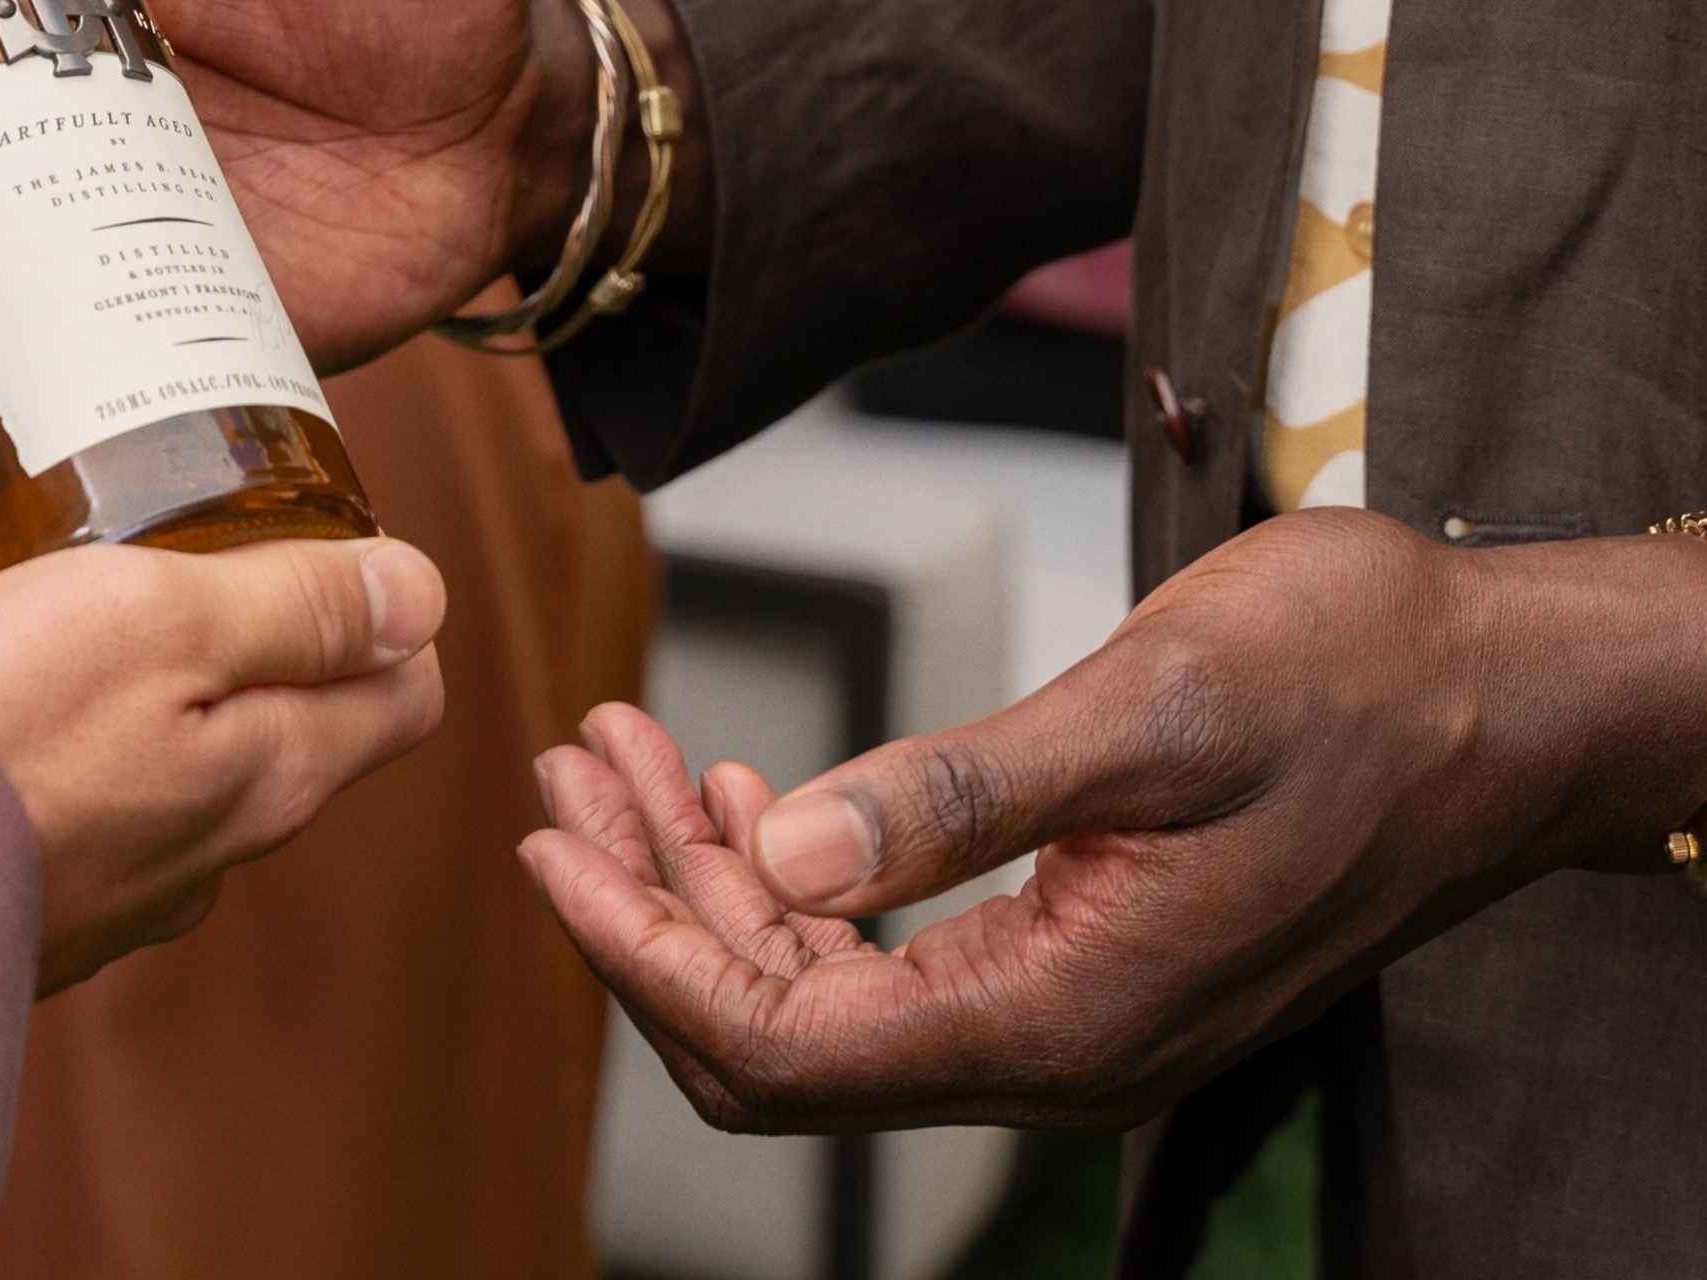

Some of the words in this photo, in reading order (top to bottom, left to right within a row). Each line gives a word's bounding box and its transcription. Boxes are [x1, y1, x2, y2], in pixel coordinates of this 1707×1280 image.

[146, 114, 193, 138] AGED
[109, 137, 127, 146] BY
[13, 174, 60, 196] THE
[75, 161, 144, 181] JAMES
[50, 181, 185, 208] DISTILLING
[98, 244, 230, 267] DISTILLED
[93, 286, 179, 312] CLERMONT
[95, 390, 152, 421] 750ML
